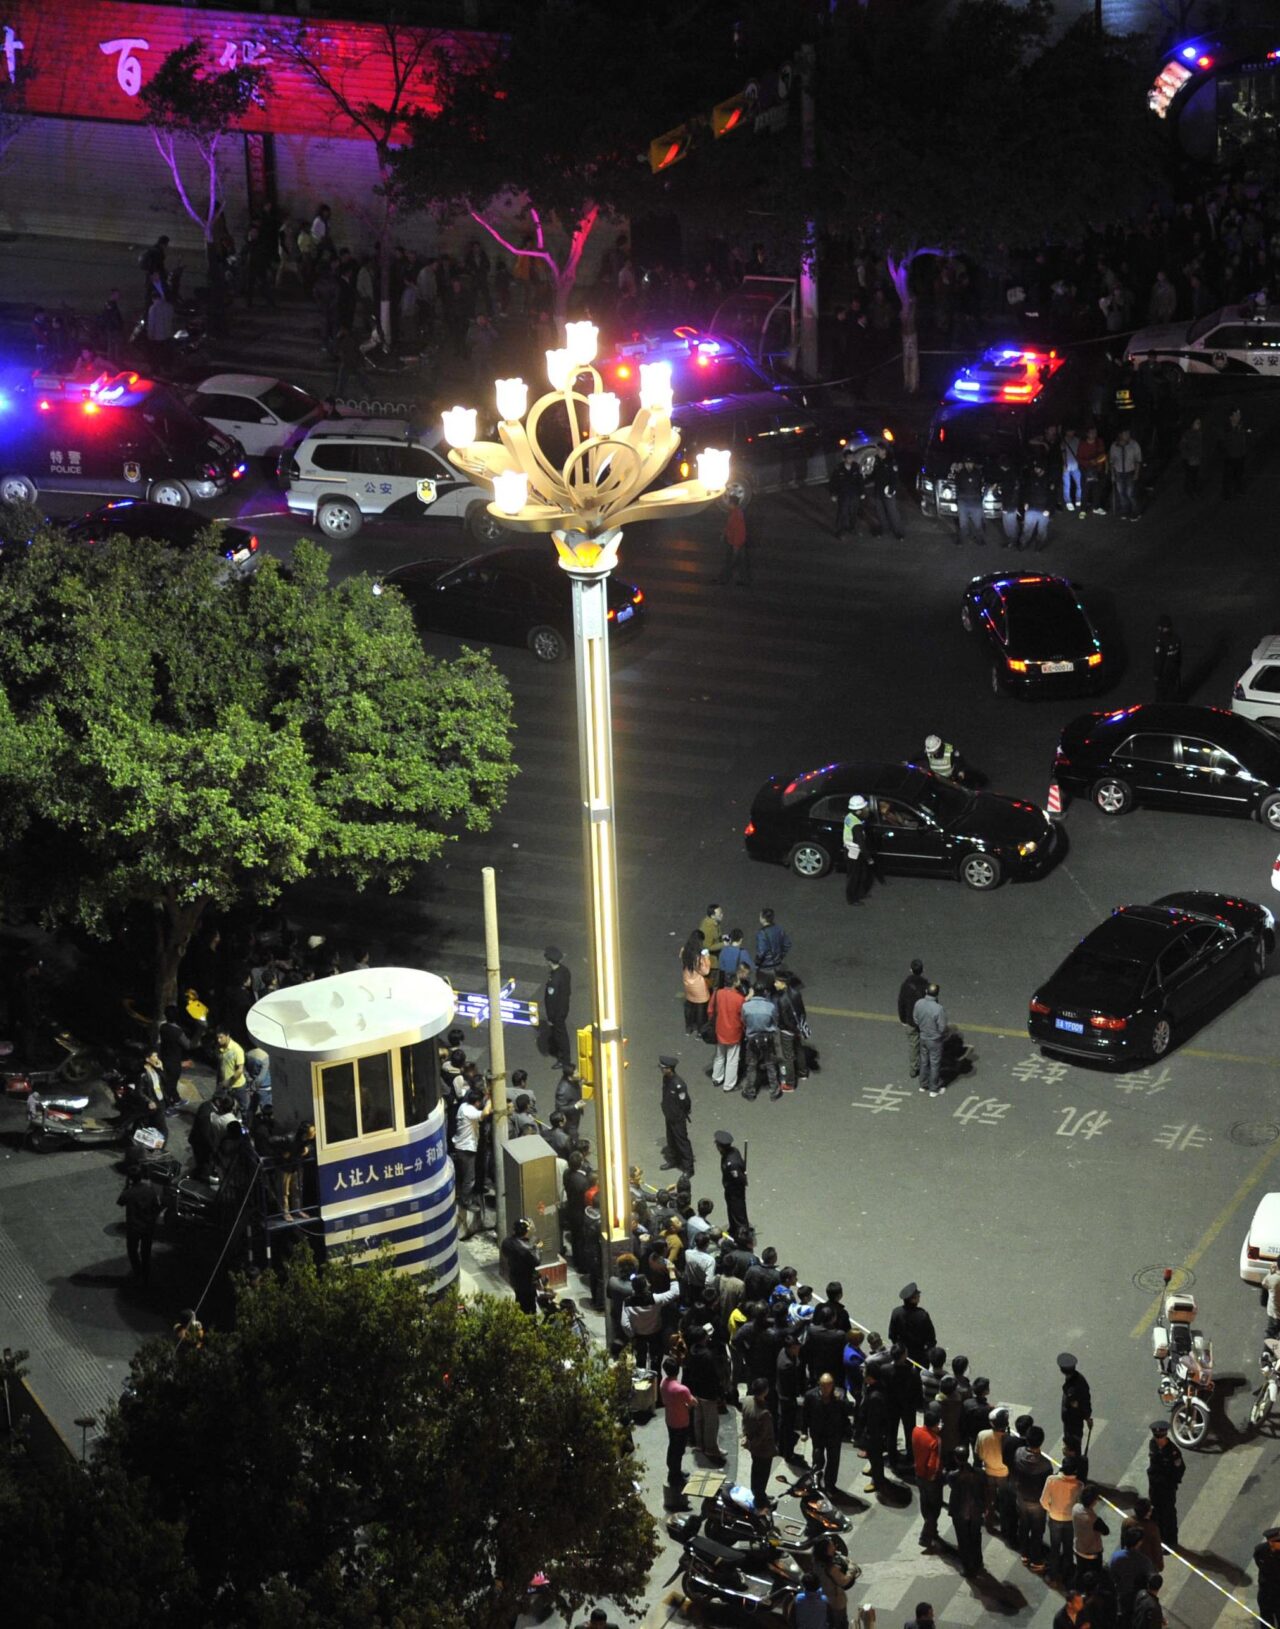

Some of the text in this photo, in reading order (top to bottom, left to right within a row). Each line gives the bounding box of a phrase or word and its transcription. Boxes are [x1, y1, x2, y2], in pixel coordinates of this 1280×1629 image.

[1253, 355, 1279, 367] 公安
[49, 464, 82, 475] POLICE
[364, 481, 393, 495] 公安
[851, 1083, 1207, 1151] 非机动车
[333, 1164, 380, 1192] 人让人
[383, 1157, 423, 1180] 让出一分
